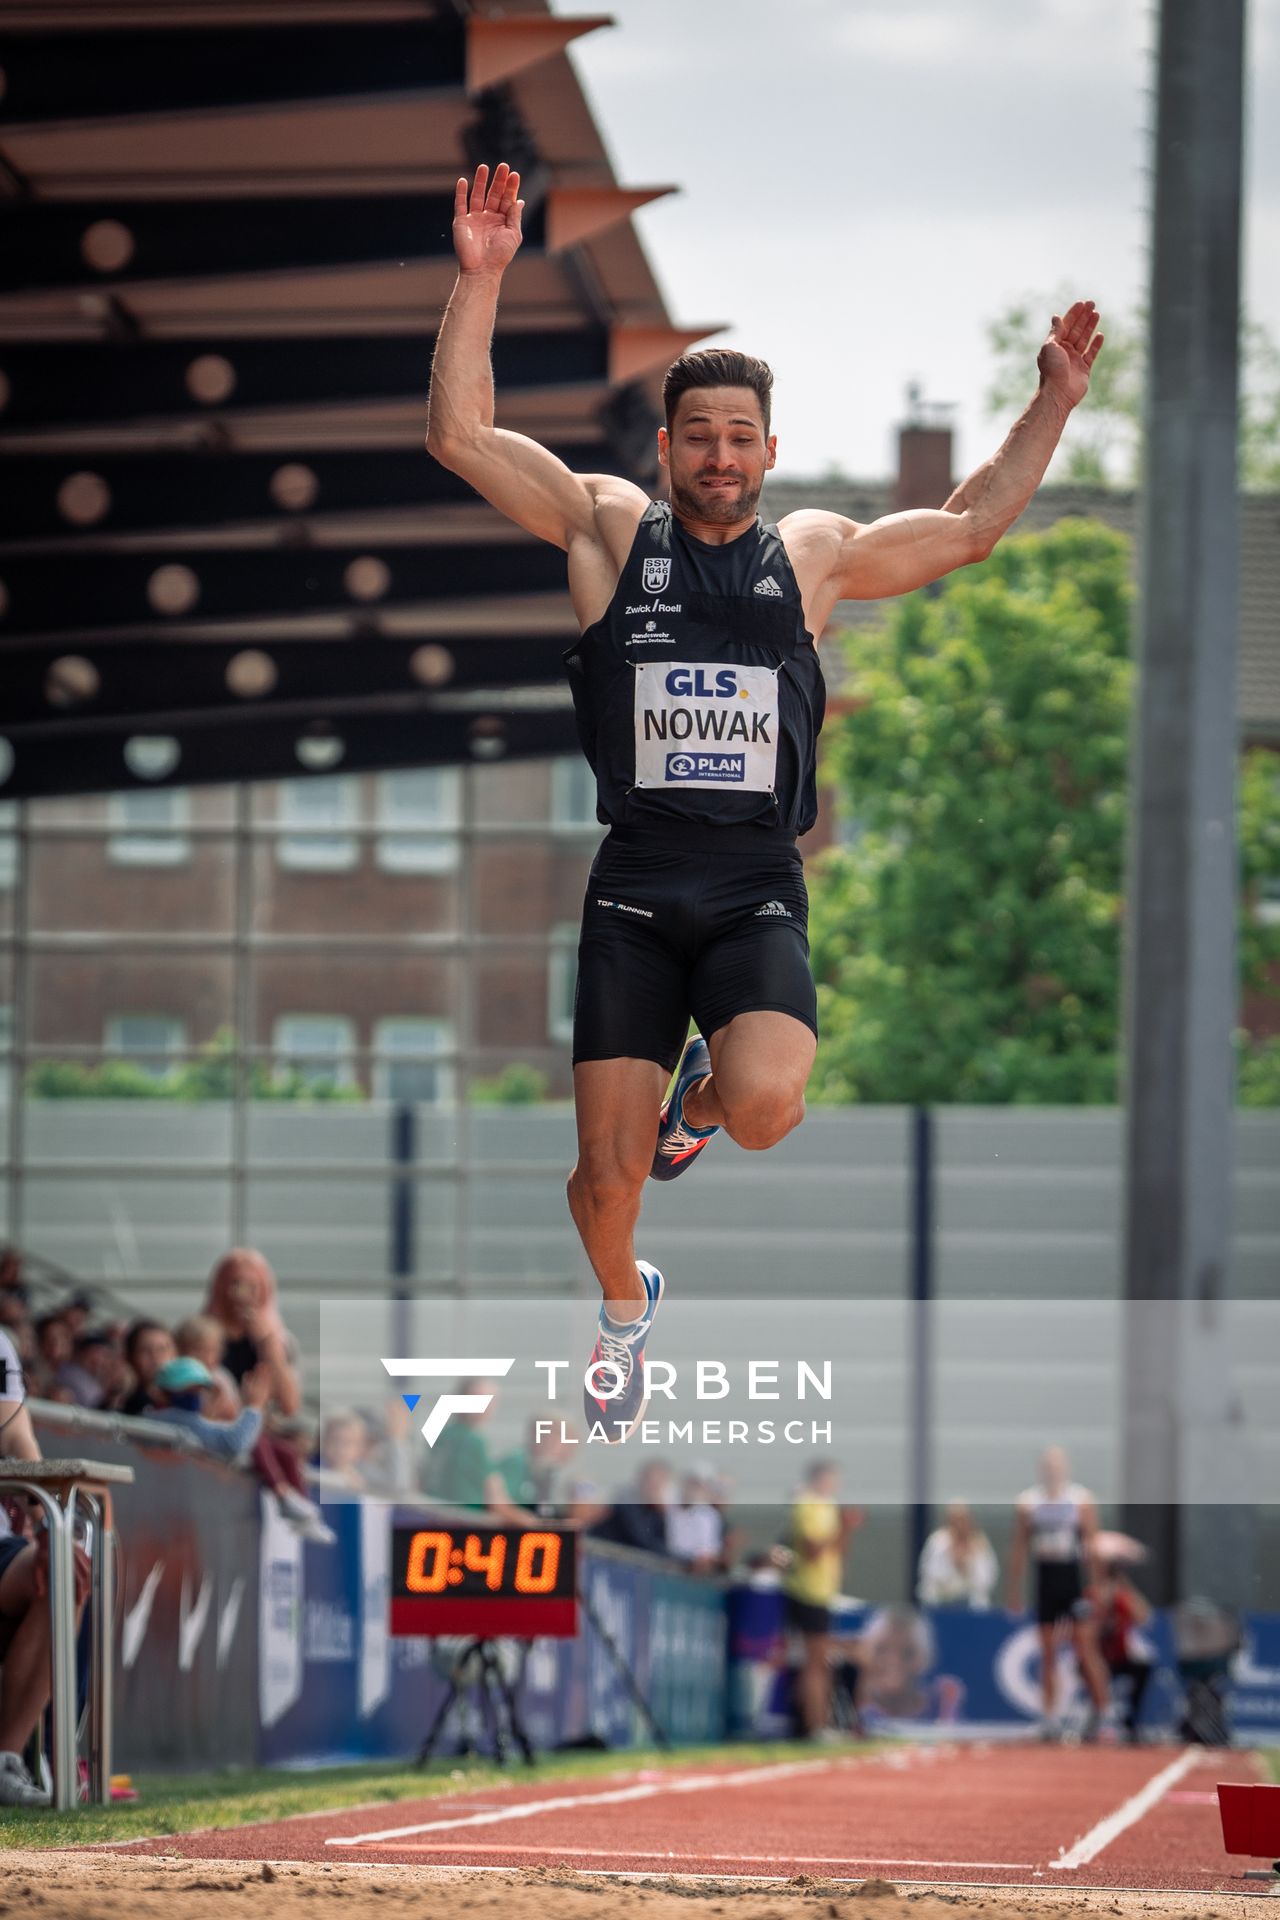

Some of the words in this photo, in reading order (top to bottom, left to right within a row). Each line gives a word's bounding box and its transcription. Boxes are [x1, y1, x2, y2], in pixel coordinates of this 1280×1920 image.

[645, 559, 670, 567] SSV
[645, 567, 669, 575] 1846
[643, 707, 772, 744] NOWAK
[698, 758, 742, 771] PLAN
[597, 899, 614, 907] TOP
[617, 903, 654, 918] RUNNING
